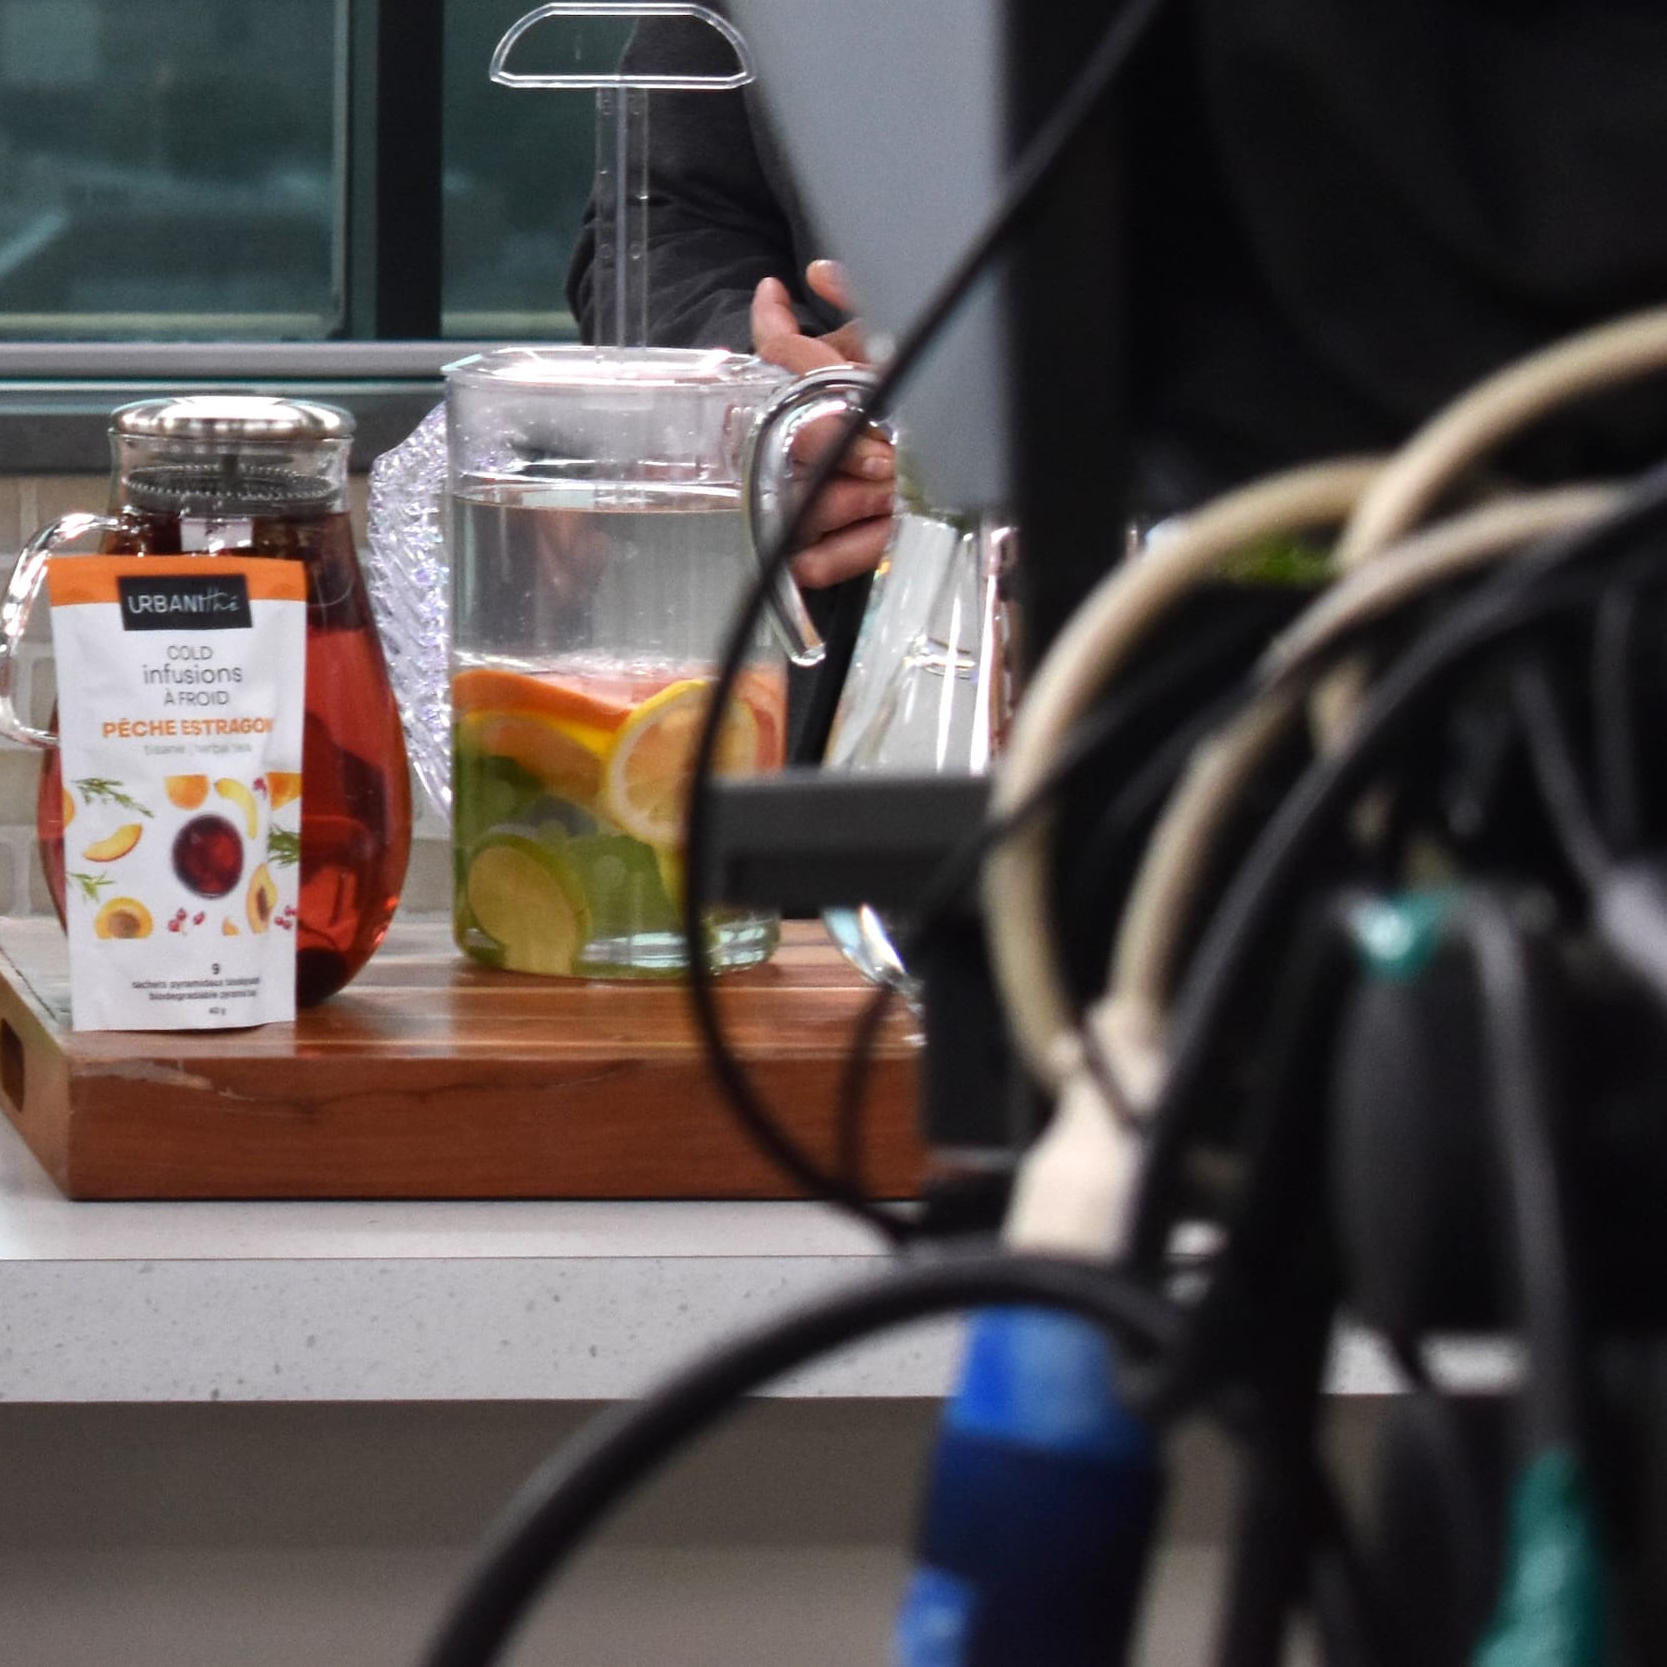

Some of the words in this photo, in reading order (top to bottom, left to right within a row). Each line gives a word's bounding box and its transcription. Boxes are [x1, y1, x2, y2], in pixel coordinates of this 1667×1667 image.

[167, 645, 213, 660] COLD
[142, 663, 243, 685] infusions
[179, 691, 230, 707] FROID
[211, 963, 220, 975] 9
